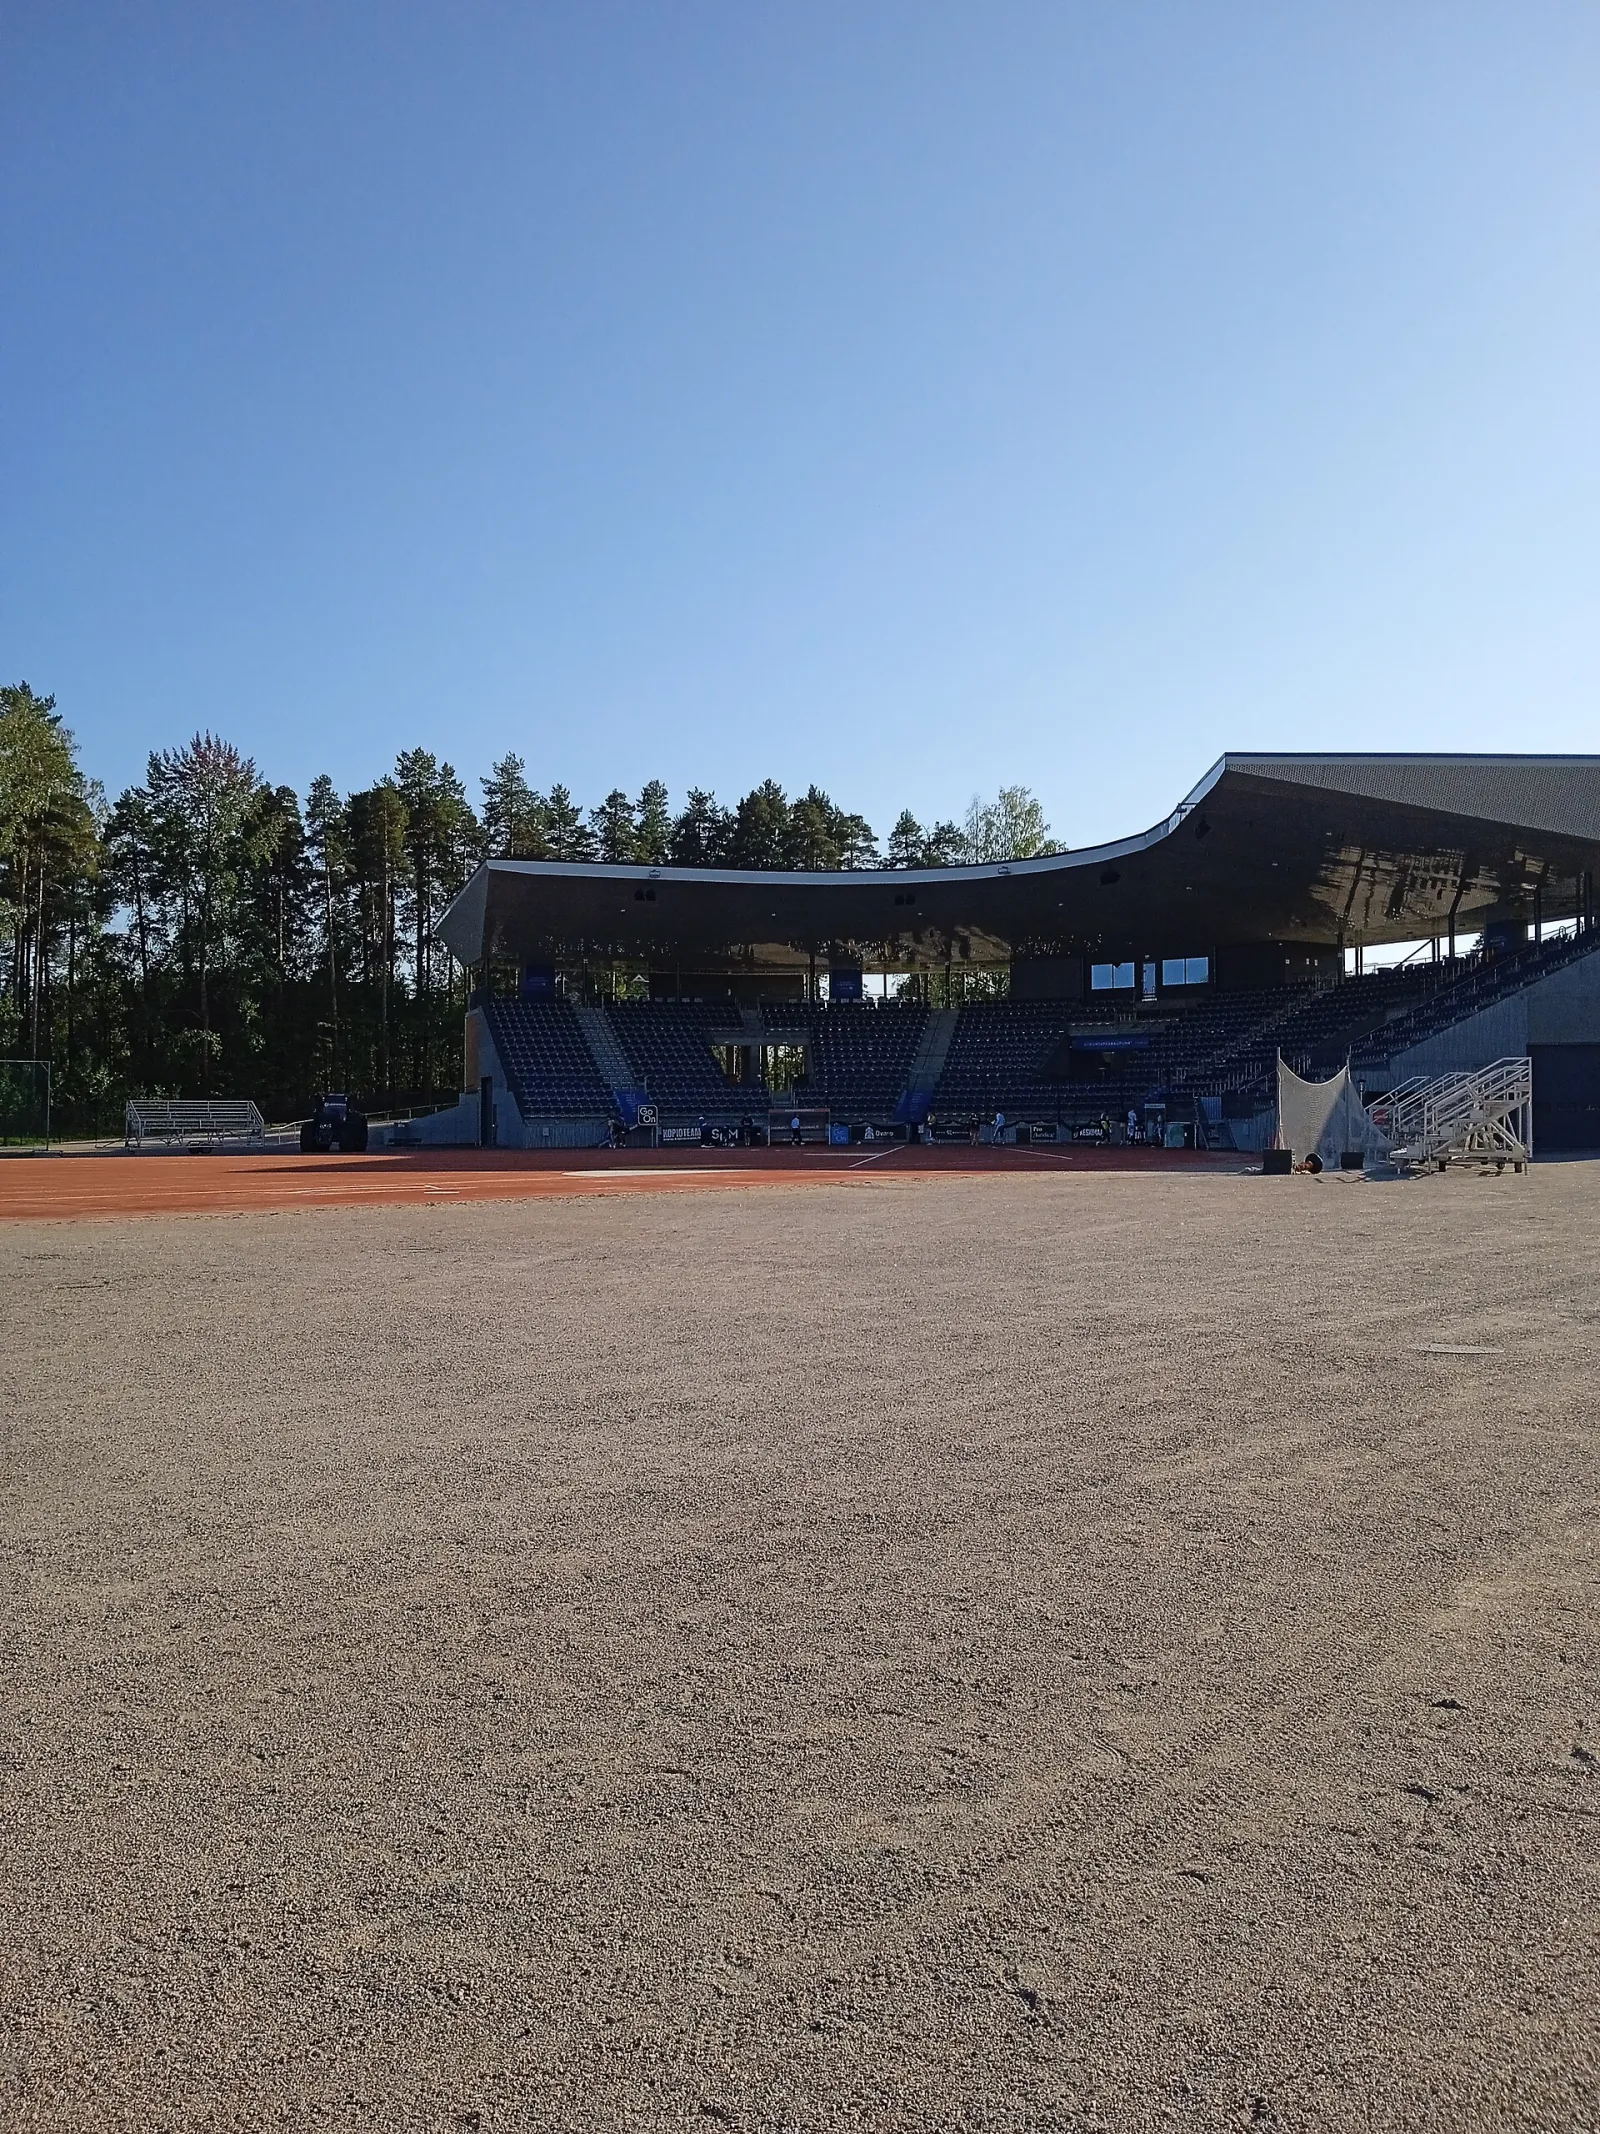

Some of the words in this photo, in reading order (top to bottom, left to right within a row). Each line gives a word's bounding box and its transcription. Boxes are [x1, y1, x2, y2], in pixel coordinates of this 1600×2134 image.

[639, 1107, 654, 1116] Go
[642, 1114, 656, 1123] On
[662, 1127, 702, 1138] KOPIOTEAM
[833, 1128, 845, 1136] Go
